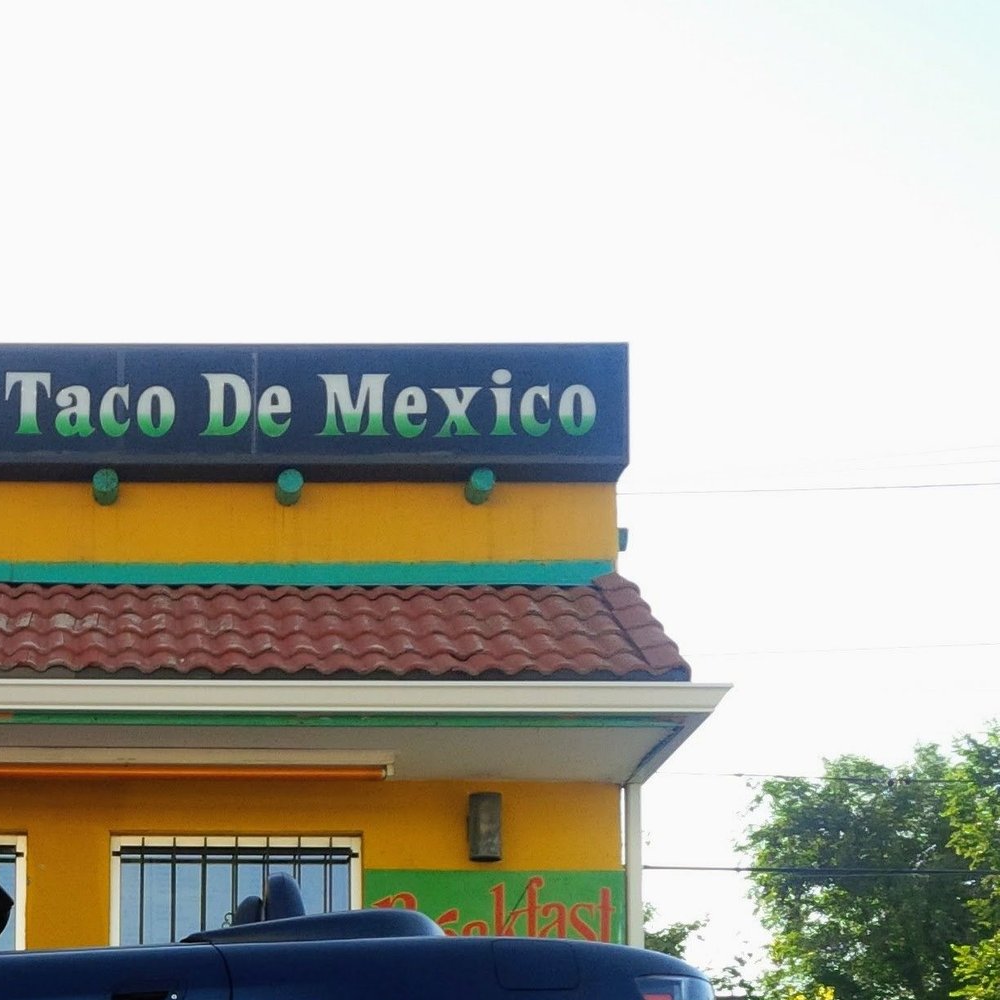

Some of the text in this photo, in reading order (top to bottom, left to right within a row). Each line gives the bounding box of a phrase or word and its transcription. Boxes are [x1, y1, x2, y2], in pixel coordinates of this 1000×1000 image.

[5, 372, 176, 438] Taco
[200, 373, 292, 437] De
[316, 369, 597, 438] Mexico
[372, 875, 616, 943] kfast
